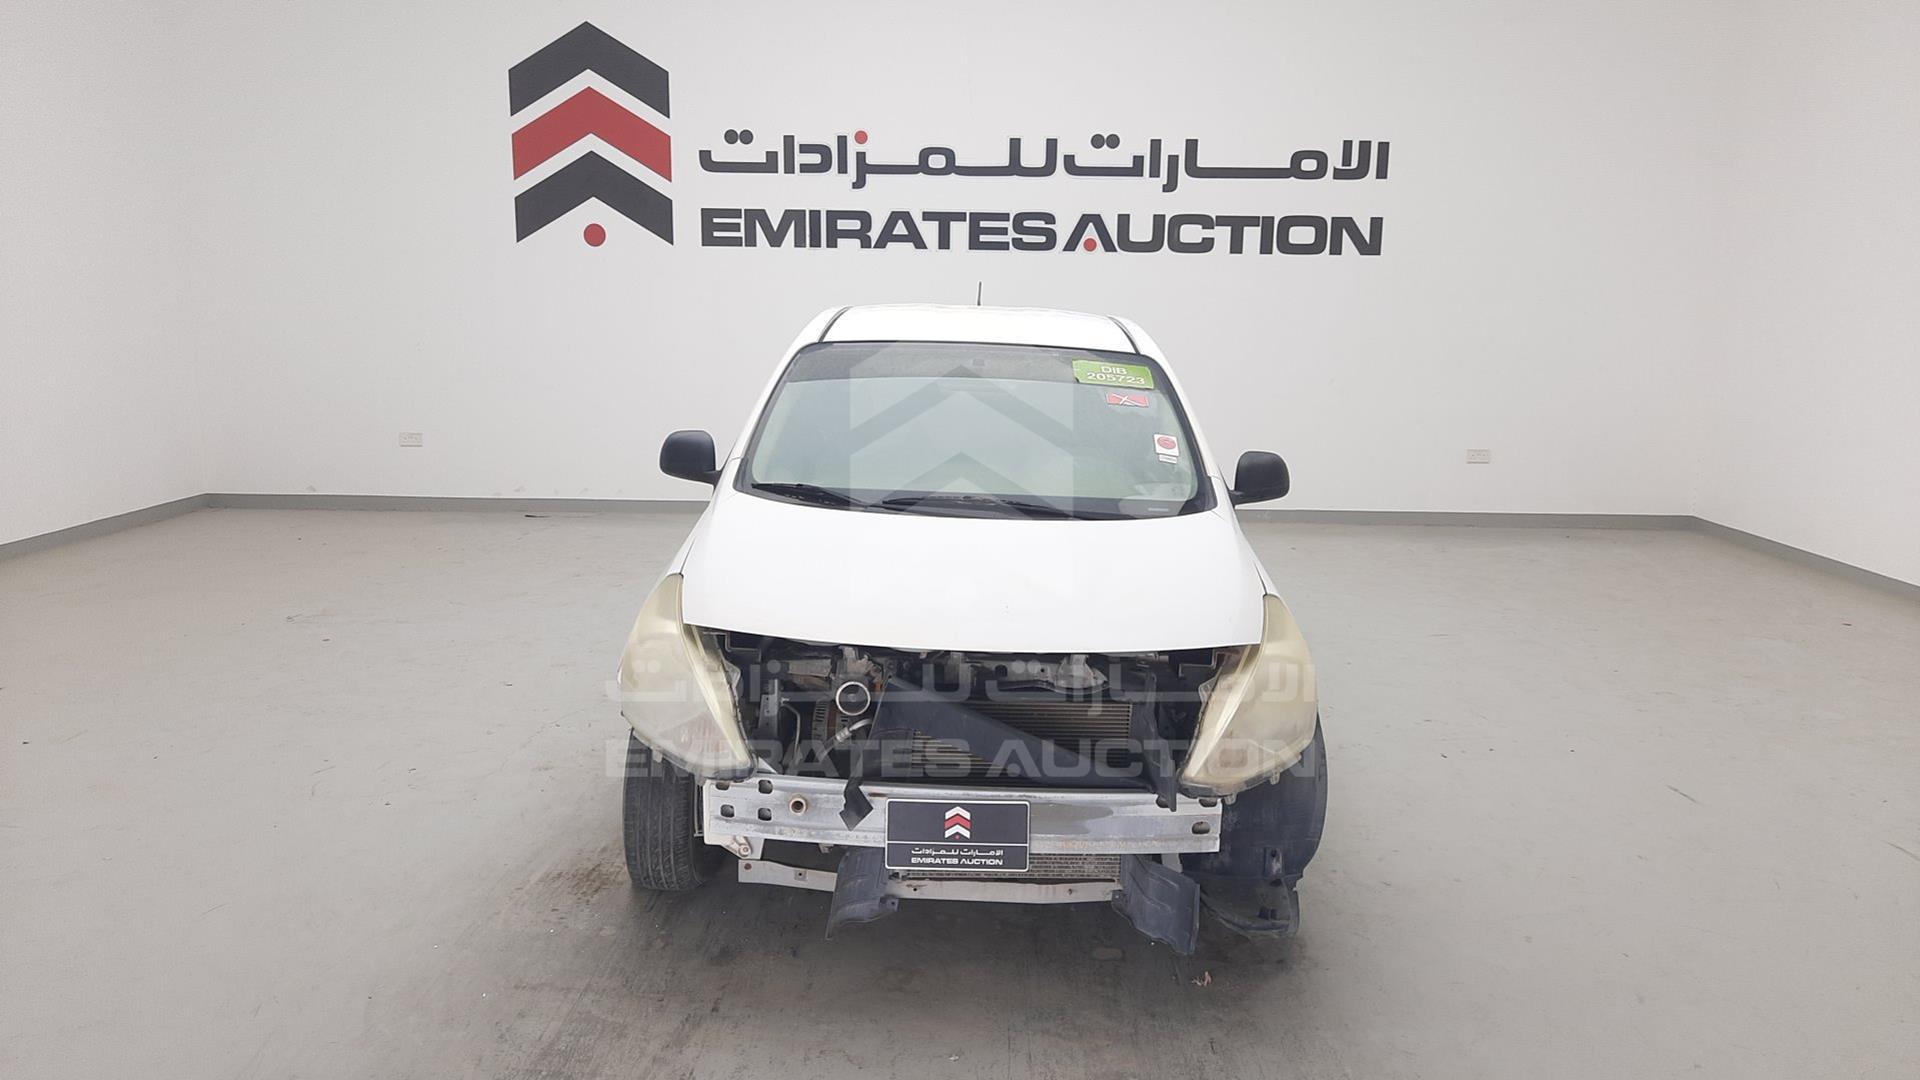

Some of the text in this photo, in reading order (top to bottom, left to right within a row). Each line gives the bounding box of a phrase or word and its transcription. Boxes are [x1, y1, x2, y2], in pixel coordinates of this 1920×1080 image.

[698, 128, 1390, 193] الامارات للمزادات
[700, 207, 1384, 256] EMIRATES AUCTION
[1101, 366, 1127, 375] DIB
[1087, 372, 1145, 385] 205723
[911, 857, 1003, 866] EMIRATES AUCTION
